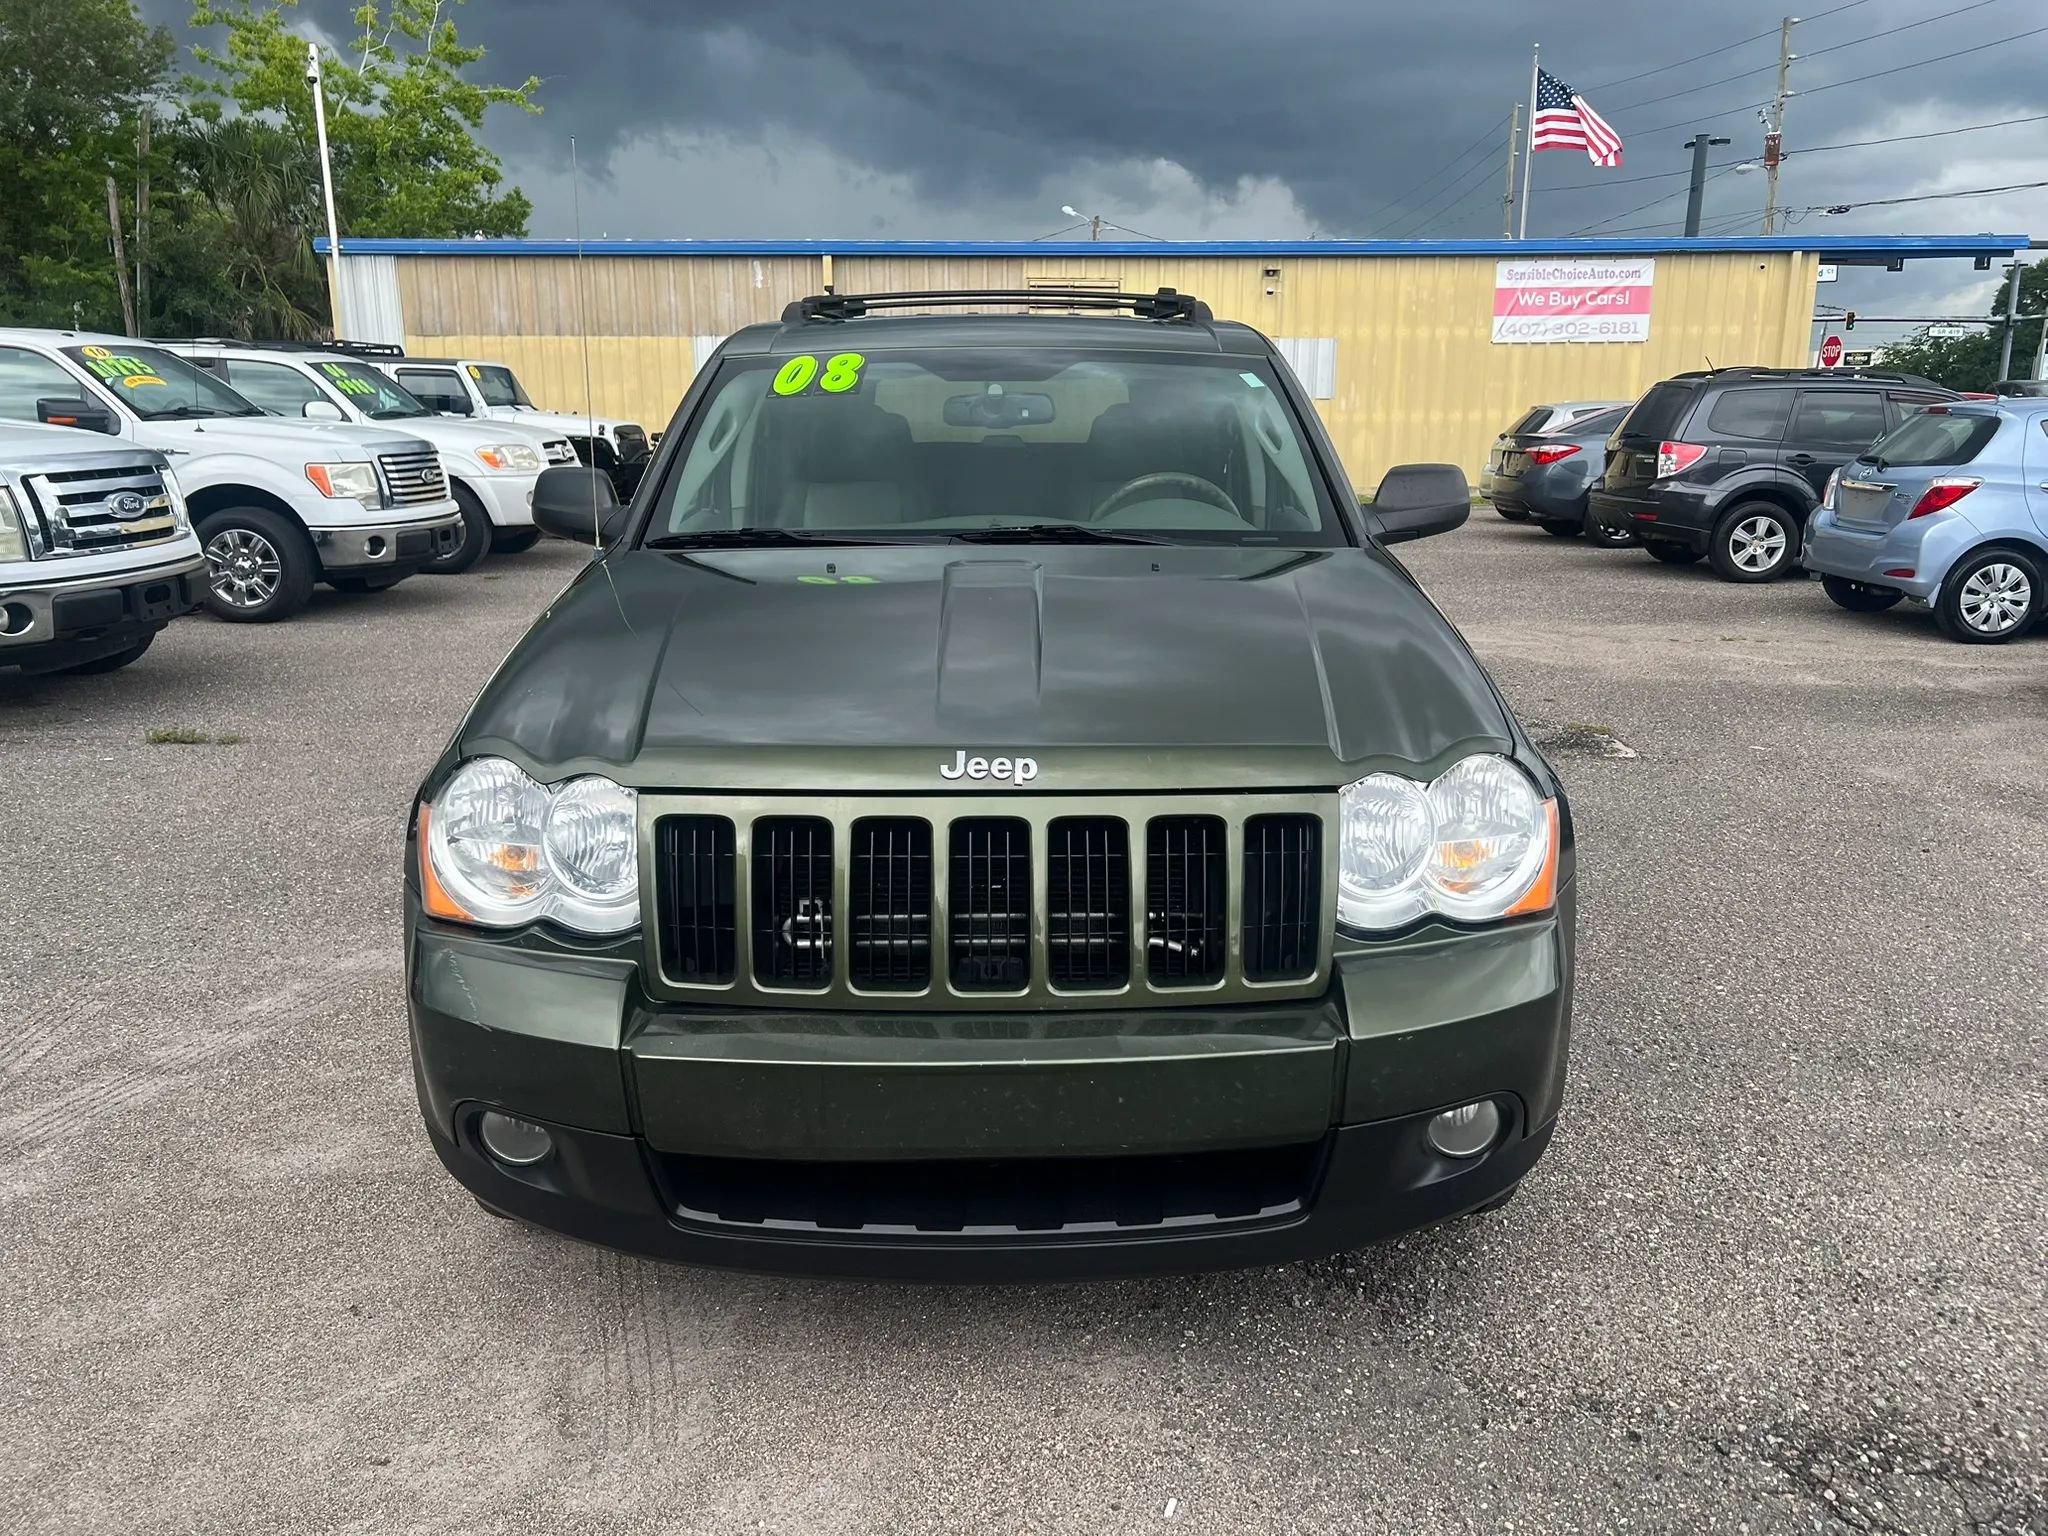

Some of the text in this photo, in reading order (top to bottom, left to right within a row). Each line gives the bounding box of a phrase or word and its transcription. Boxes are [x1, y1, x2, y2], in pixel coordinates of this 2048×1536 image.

[1507, 267, 1641, 281] SensibleChoiceAuto.com
[1518, 290, 1630, 309] We Buy Cars!
[1822, 344, 1841, 358] STOP
[773, 353, 865, 396] 08
[123, 497, 140, 510] Ford
[940, 750, 1038, 786] Jeep
